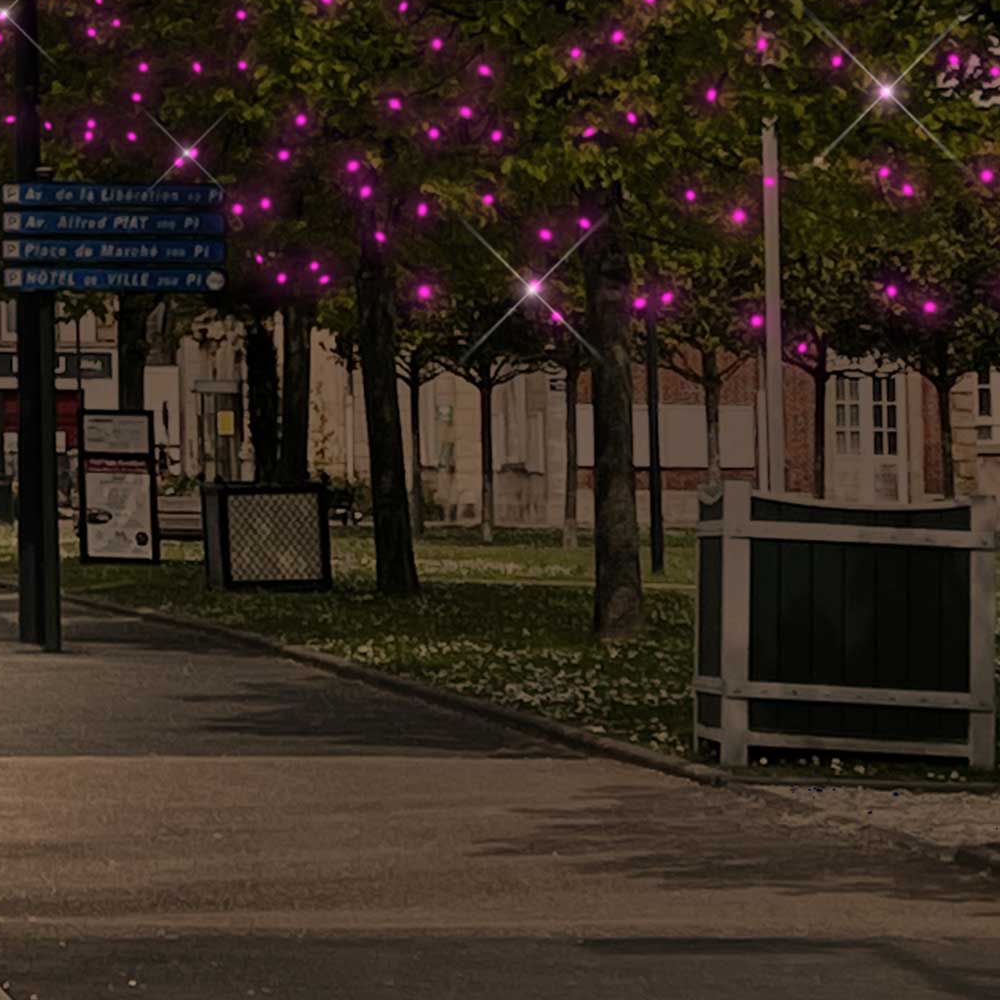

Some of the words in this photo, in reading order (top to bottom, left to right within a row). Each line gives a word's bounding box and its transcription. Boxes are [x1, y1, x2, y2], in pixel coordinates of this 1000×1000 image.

[55, 187, 74, 202] de
[56, 215, 108, 230] Alfred
[23, 242, 68, 257] Place
[99, 243, 159, 258] Marché
[25, 268, 76, 287] HÔTEL
[107, 272, 150, 287] VILLE
